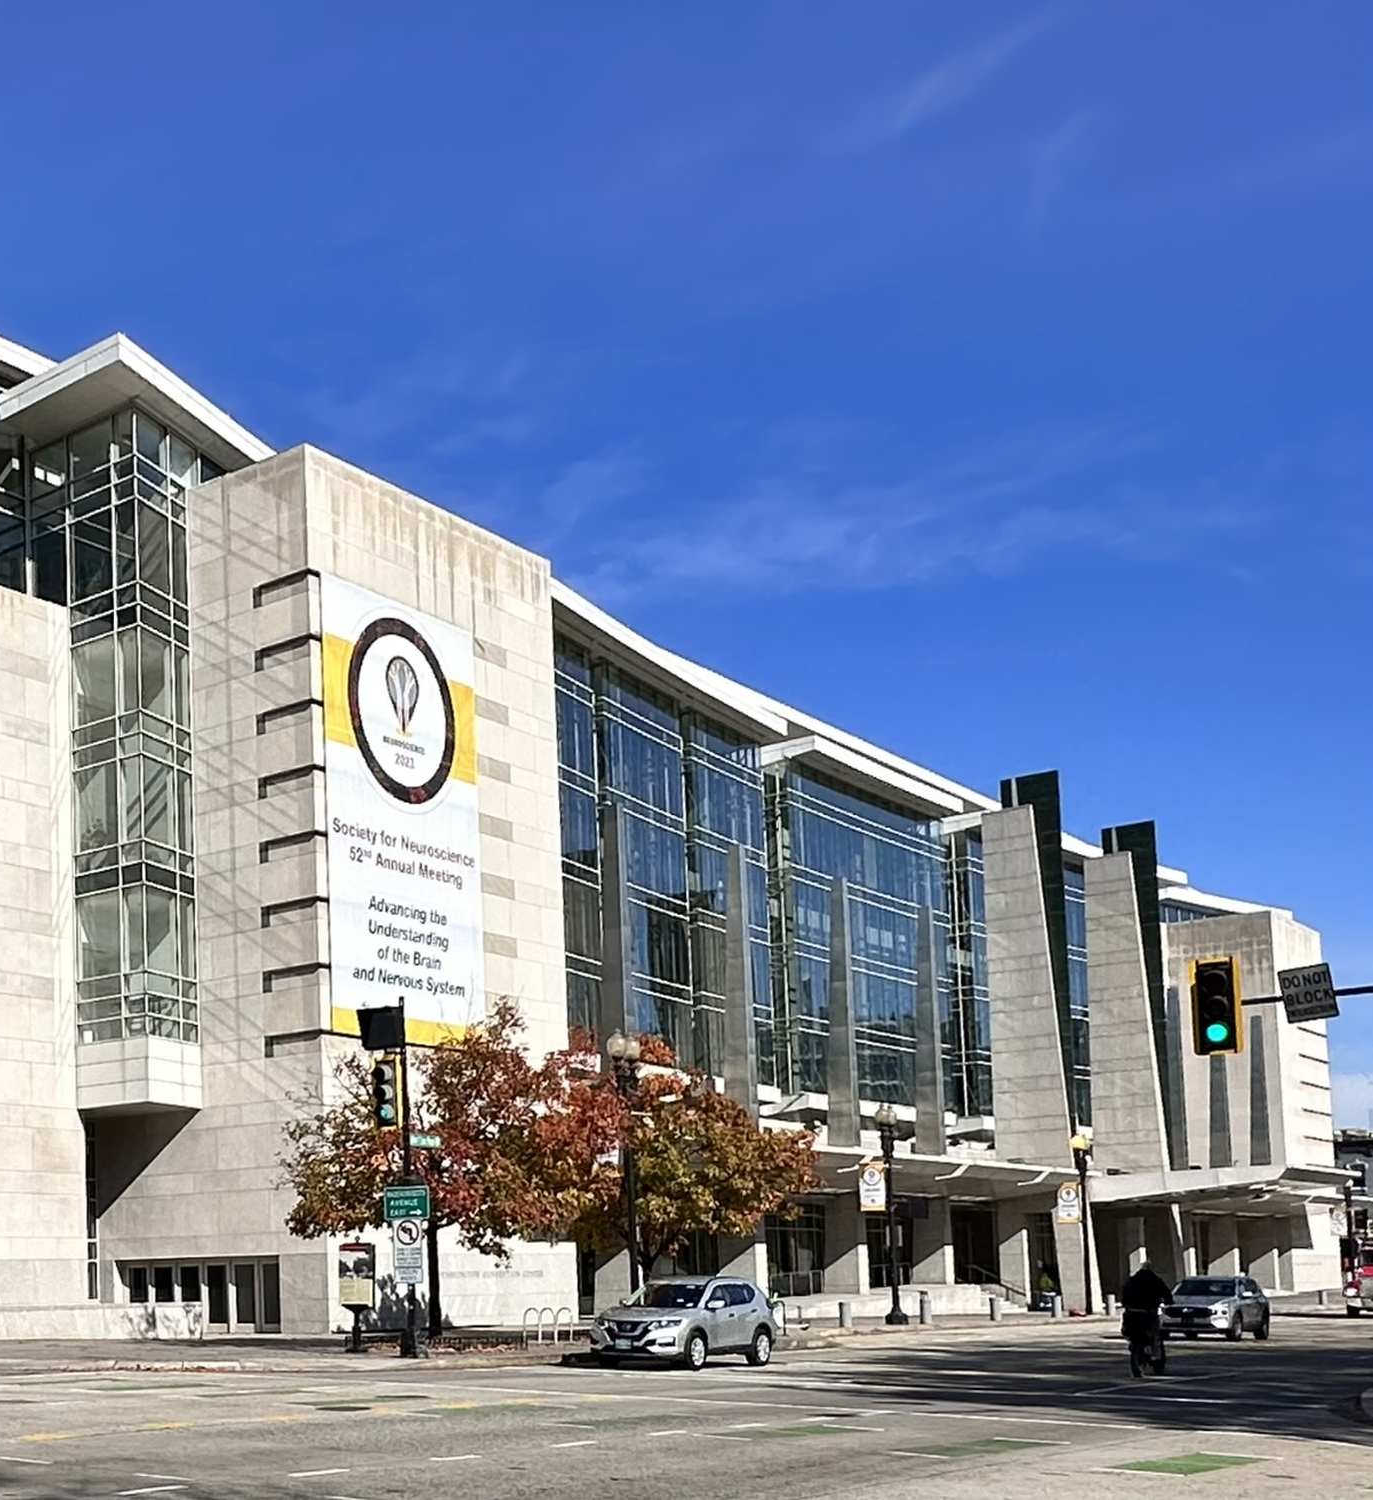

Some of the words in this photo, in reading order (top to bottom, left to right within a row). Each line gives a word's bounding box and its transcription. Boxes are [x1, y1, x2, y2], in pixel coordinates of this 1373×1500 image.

[332, 817, 377, 845] Society
[380, 830, 397, 848] for
[401, 835, 475, 868] Neuroscience
[375, 853, 415, 875] Annual
[418, 862, 462, 890] Meeting
[368, 896, 427, 924] Advancing
[430, 909, 447, 926] the
[368, 919, 449, 952] Understanding
[377, 945, 390, 960] of
[393, 948, 410, 964] the
[413, 951, 442, 970] Brain
[352, 966, 376, 982] and
[378, 968, 423, 991] Nervous
[426, 976, 465, 998] System
[1282, 975, 1301, 990] DO
[1301, 971, 1327, 987] NOT
[1286, 988, 1334, 1006] BLOCK
